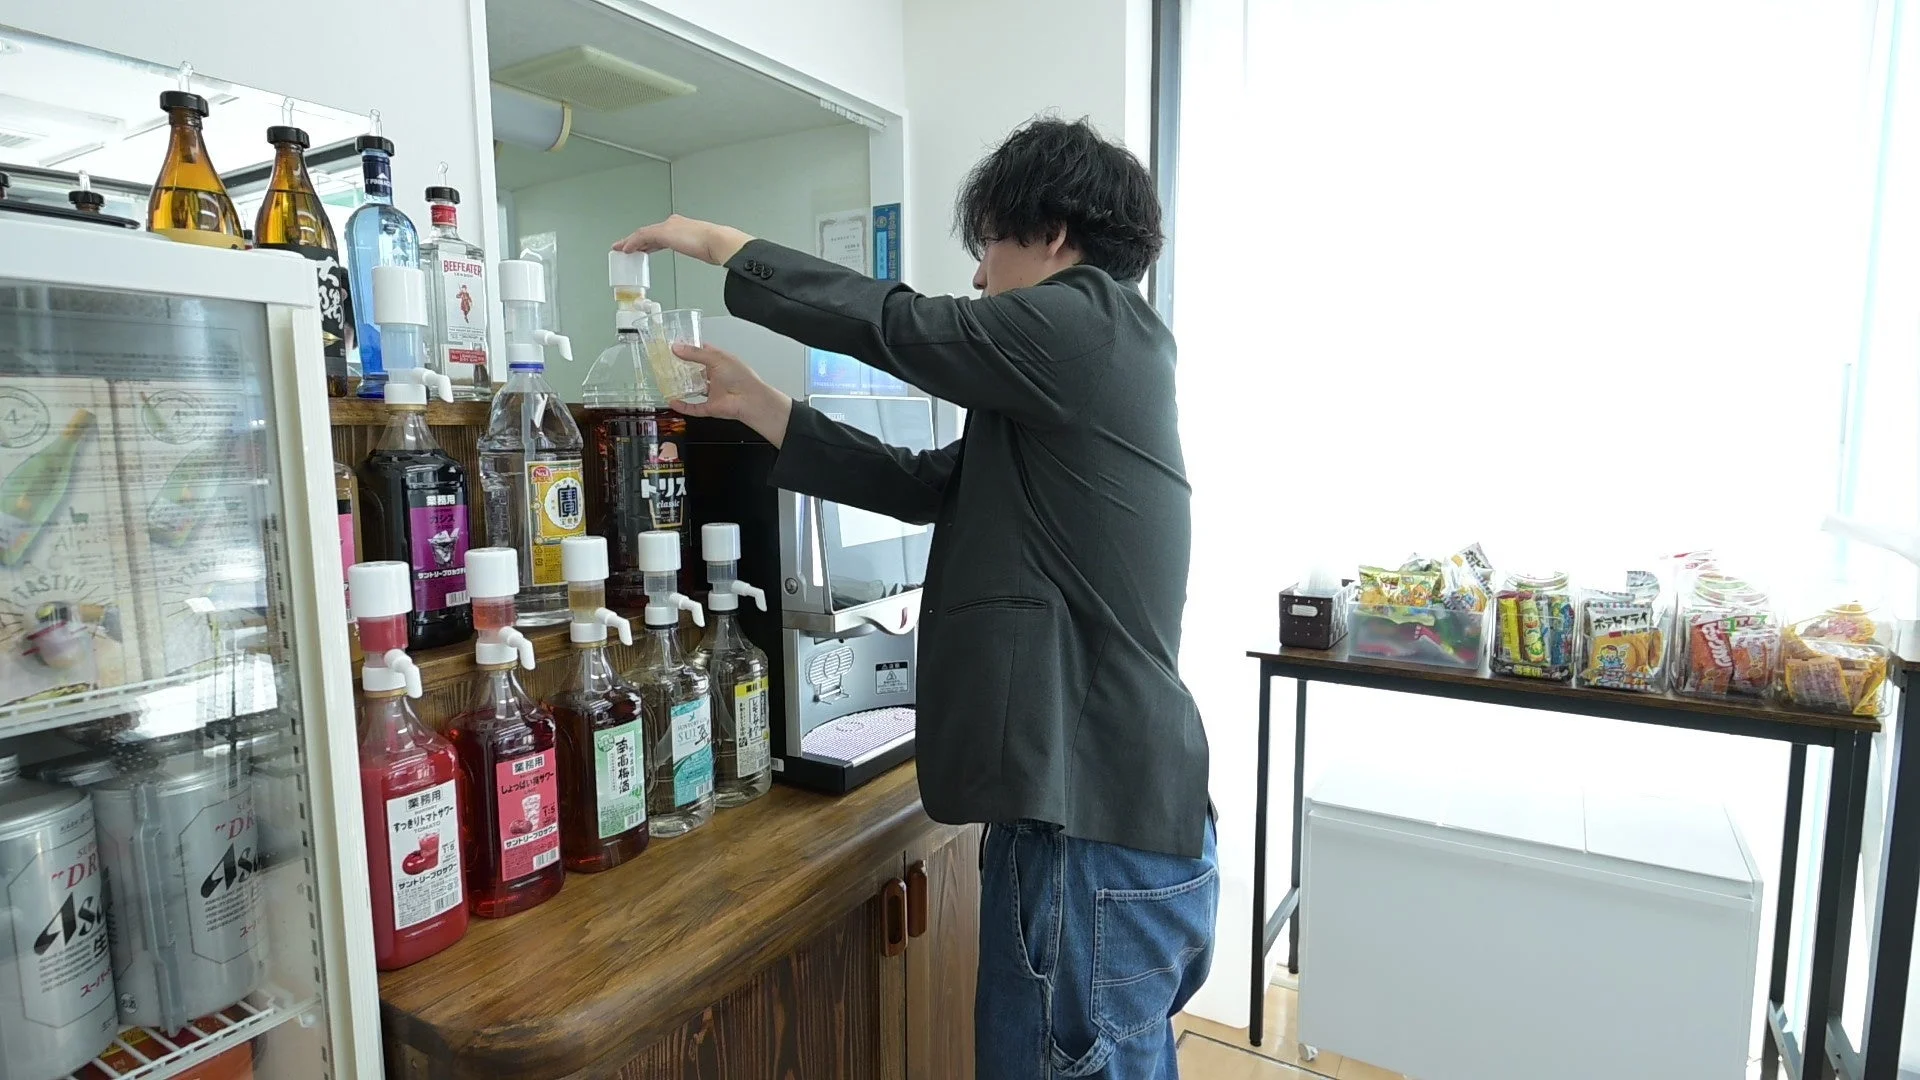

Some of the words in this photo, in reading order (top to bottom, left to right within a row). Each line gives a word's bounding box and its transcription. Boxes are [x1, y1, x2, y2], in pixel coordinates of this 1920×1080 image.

[443, 259, 482, 277] BEEFEATER
[641, 477, 687, 498] トリス
[426, 494, 455, 506] 業務用
[656, 499, 680, 509] classic
[1593, 612, 1648, 630] ポテトフライ
[678, 728, 697, 742] SUI
[514, 756, 543, 773] 業務用
[616, 737, 630, 794] 南高梅酒
[407, 789, 441, 809] 業務用
[393, 805, 454, 833] すっきりトマトサワー
[543, 807, 556, 817] 1:5
[414, 821, 441, 834] TOMATO
[505, 826, 556, 848] サントリープロサワー
[398, 863, 457, 890] サントリープロサワー
